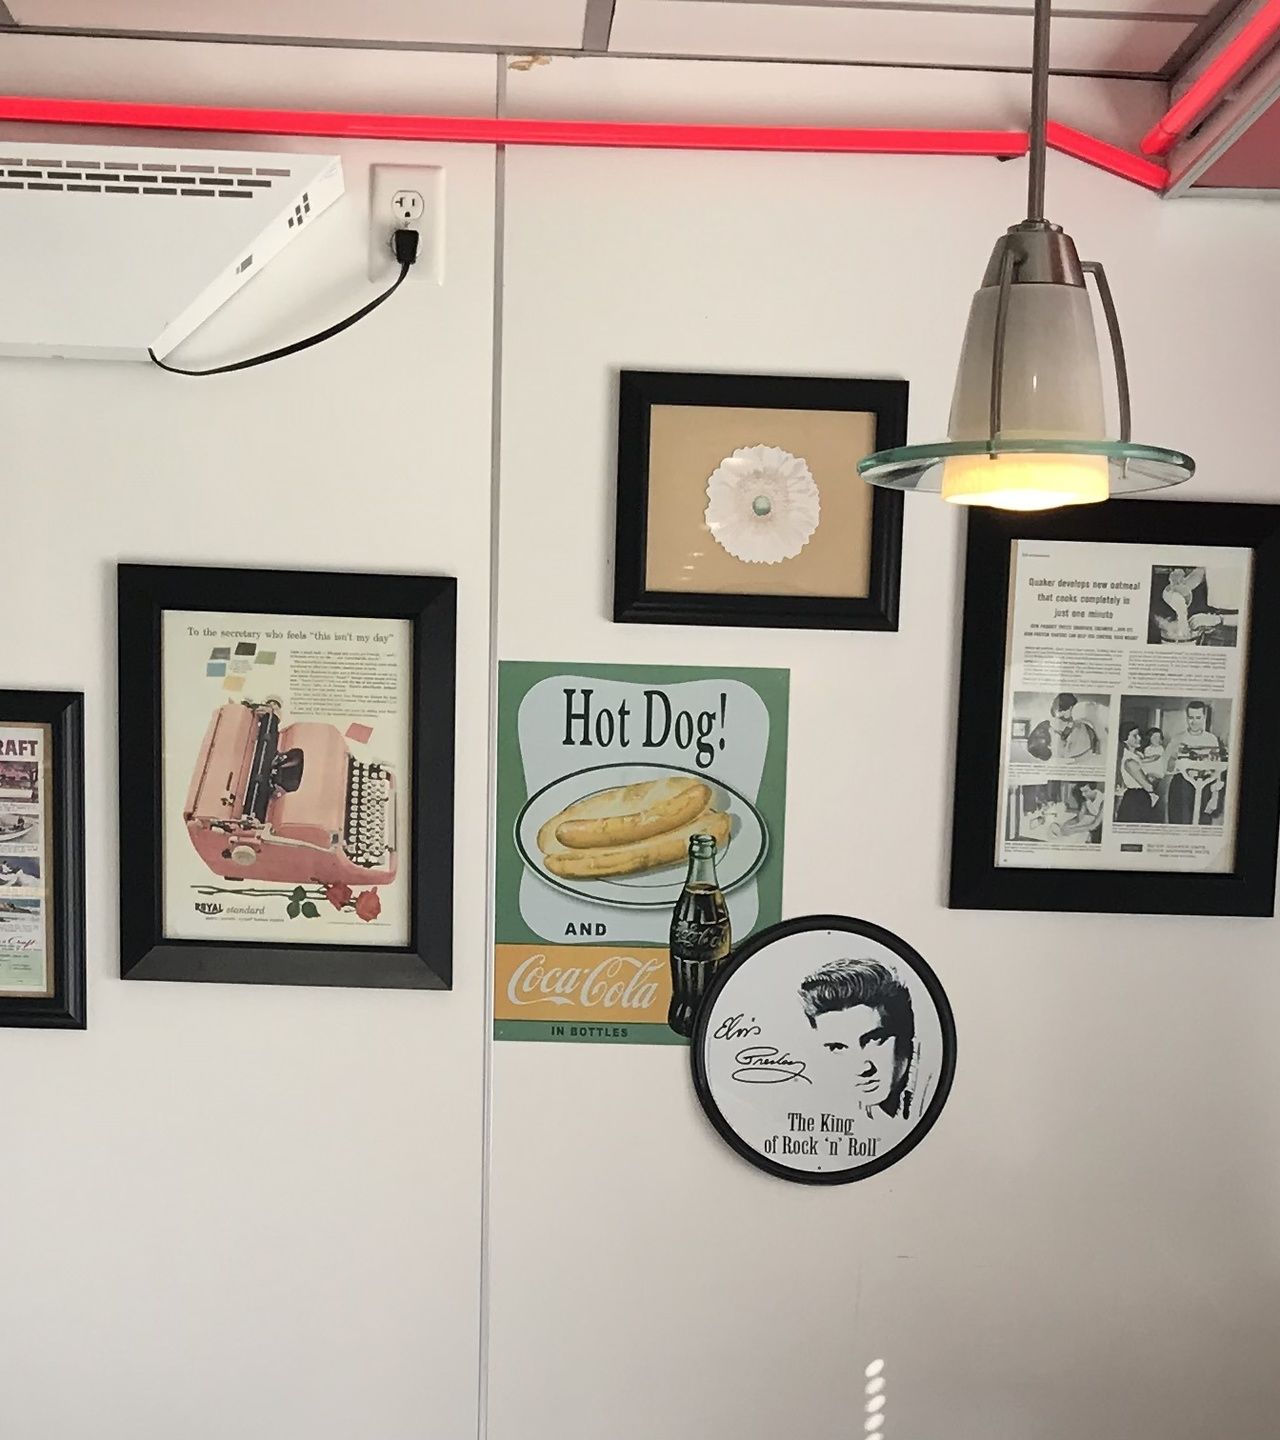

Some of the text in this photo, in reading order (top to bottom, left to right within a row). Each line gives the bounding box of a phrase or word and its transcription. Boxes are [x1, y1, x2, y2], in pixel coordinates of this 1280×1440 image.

[1028, 577, 1055, 587] Quaker
[1057, 579, 1090, 590] develops
[1110, 581, 1141, 591] oatmeal
[1037, 593, 1053, 602] that
[1080, 596, 1121, 606] completely
[1054, 608, 1114, 619] just one minute
[187, 626, 200, 637] To
[203, 627, 218, 637] the
[220, 629, 261, 641] secretary
[265, 629, 284, 639] who
[286, 630, 307, 640] feels
[334, 631, 353, 641] isn't
[356, 634, 370, 643] my
[562, 688, 727, 769] Hot Dog!
[195, 902, 266, 915] ROYAL standard
[565, 922, 608, 936] AND
[507, 953, 666, 1010] Coca-Cola
[550, 1025, 629, 1038] IN BOTTLES
[713, 1013, 762, 1040] Elvis
[787, 1112, 855, 1136] The King
[764, 1135, 780, 1155] of
[782, 1135, 819, 1155] Rock
[848, 1138, 878, 1157] Roll
